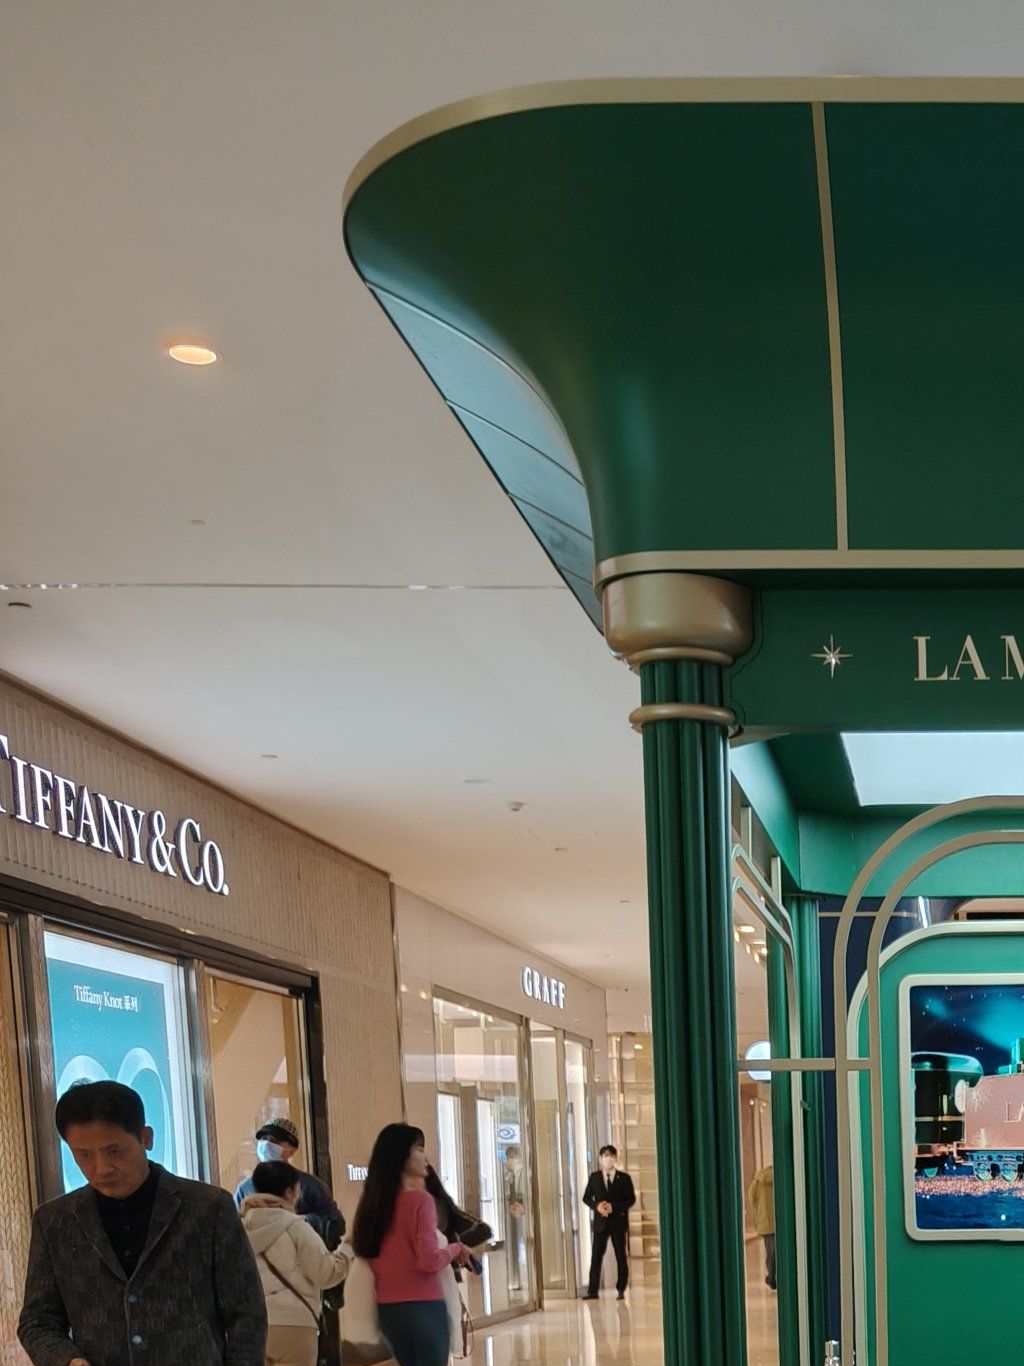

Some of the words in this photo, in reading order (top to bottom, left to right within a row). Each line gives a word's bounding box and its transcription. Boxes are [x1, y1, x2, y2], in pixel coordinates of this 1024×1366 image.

[913, 634, 991, 681] LA
[73, 985, 102, 1011] Tiffany
[103, 991, 123, 1010] Knot
[523, 966, 566, 1009] GRAFF
